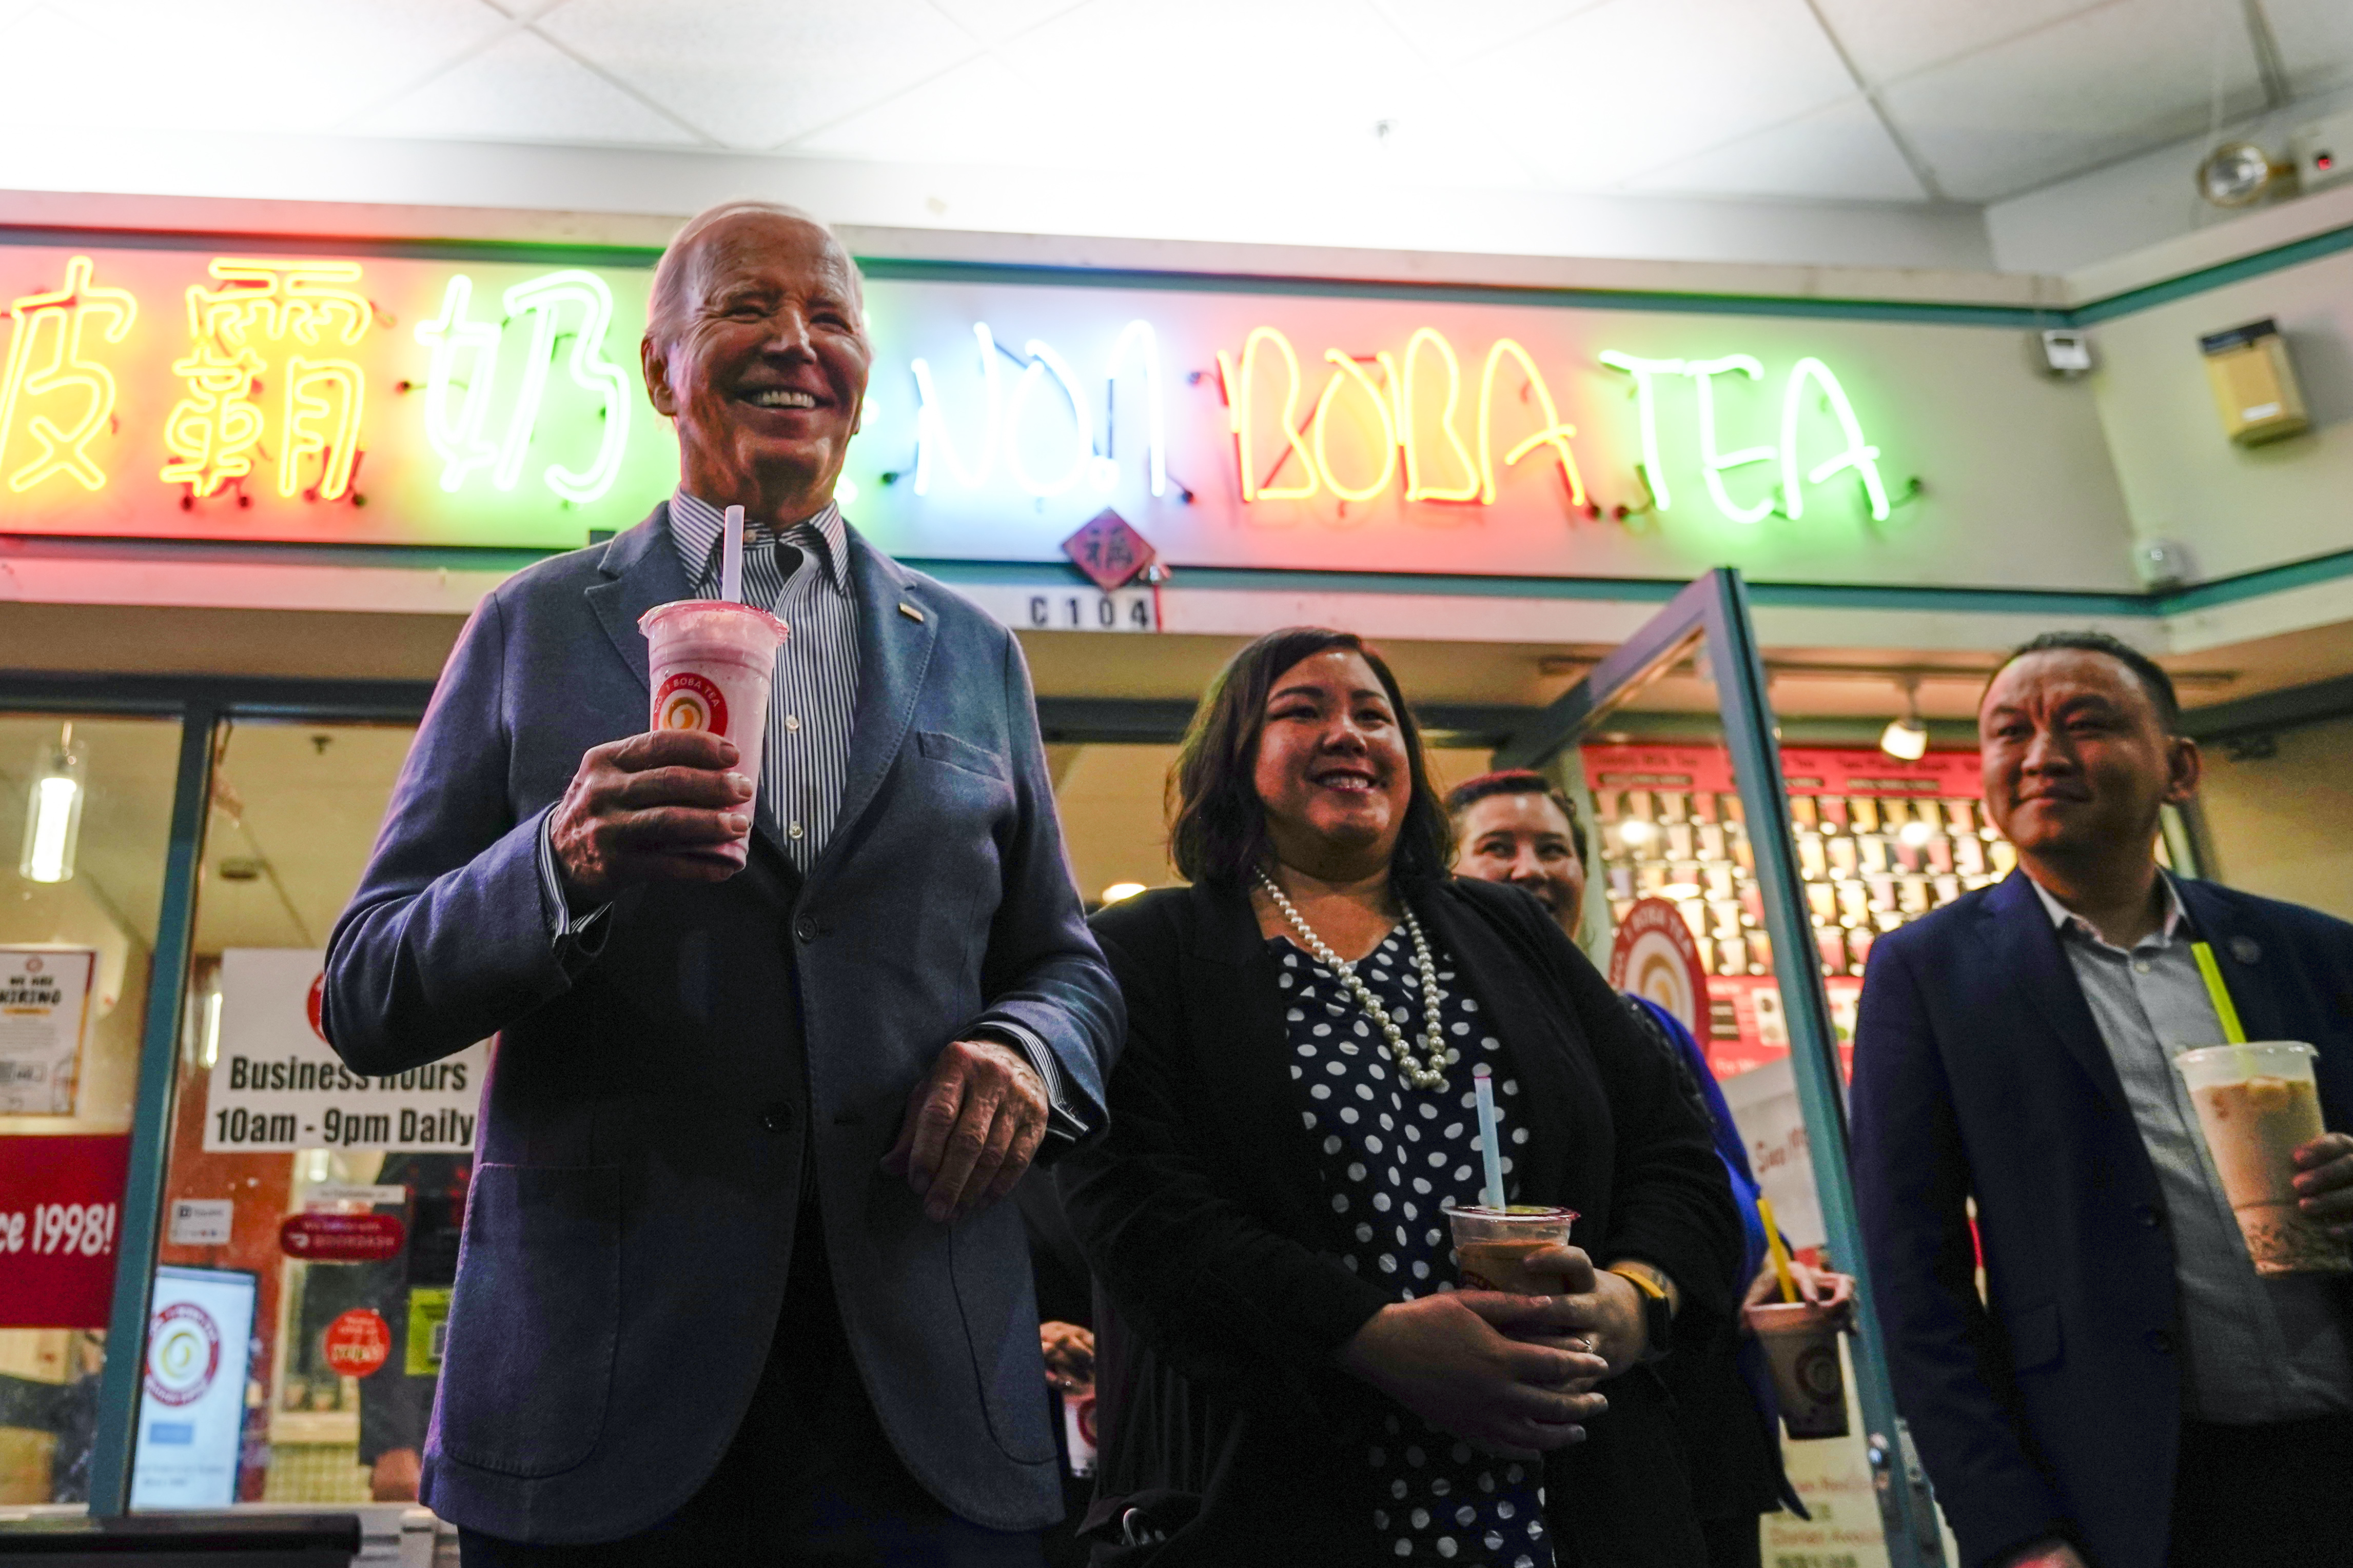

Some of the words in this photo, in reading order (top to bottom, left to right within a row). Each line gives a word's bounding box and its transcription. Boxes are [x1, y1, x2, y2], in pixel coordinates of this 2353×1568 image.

[1217, 326, 1586, 507] BOBA
[1598, 350, 1890, 523] TEA
[1030, 596, 1147, 627] C104
[673, 677, 701, 689] BOBA
[704, 685, 720, 707] TEA
[217, 1109, 296, 1142] 10am
[324, 1108, 389, 1146] 9pm
[400, 1108, 474, 1146] Daily
[32, 1203, 116, 1256] 1998!
